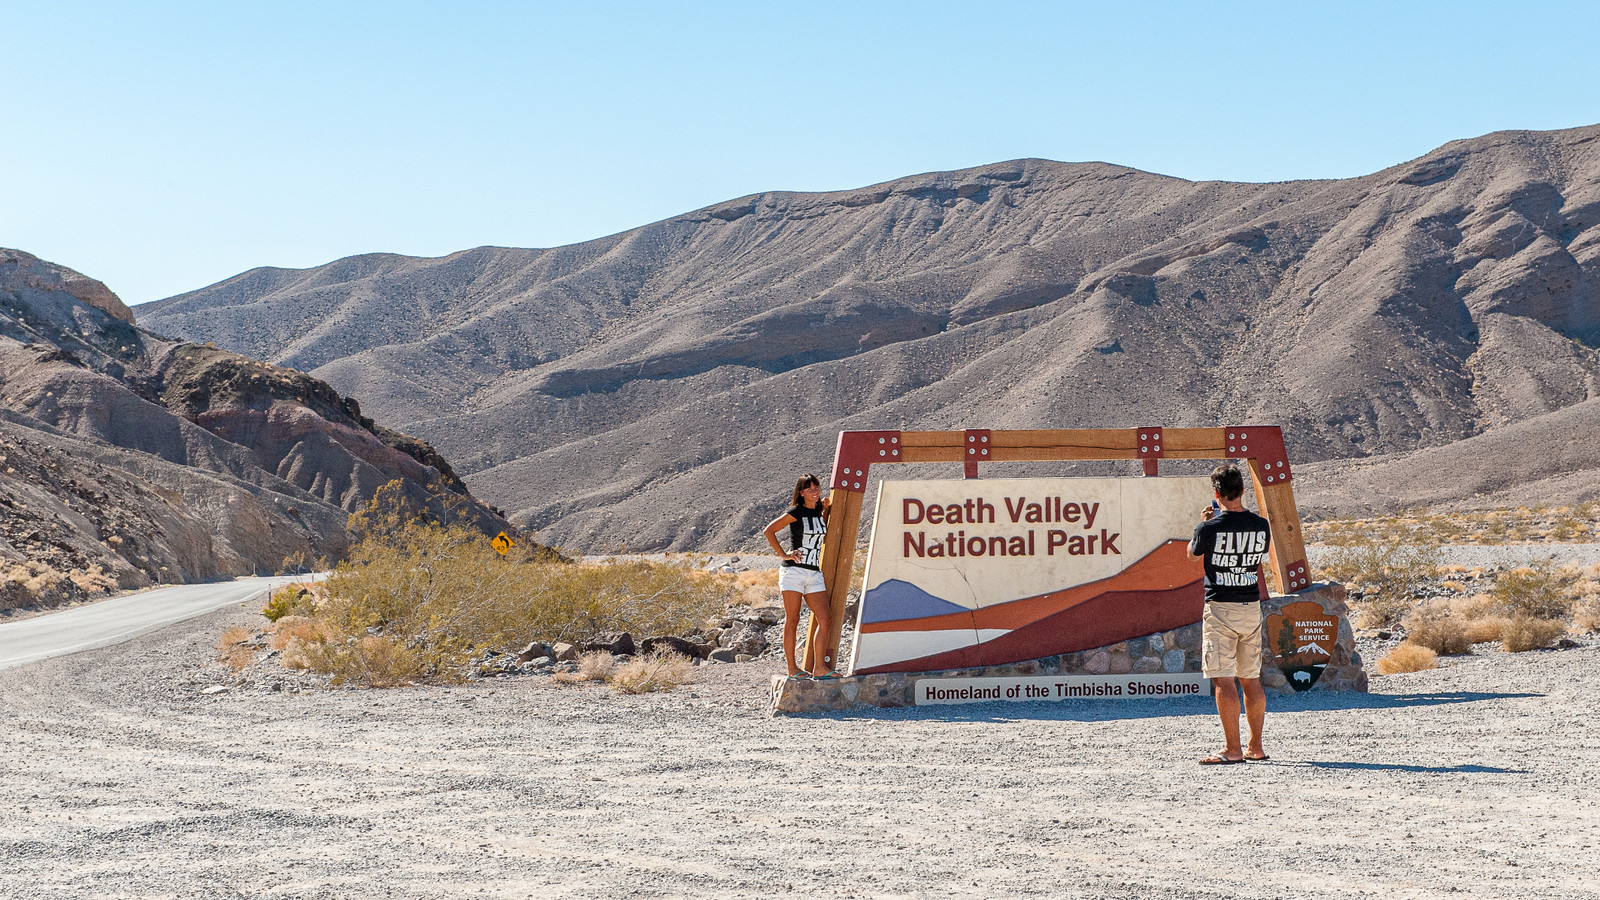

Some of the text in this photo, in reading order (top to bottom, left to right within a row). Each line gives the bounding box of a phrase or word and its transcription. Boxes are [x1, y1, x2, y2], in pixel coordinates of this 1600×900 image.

[903, 496, 1100, 529] Death Valley
[903, 528, 1122, 558] National Park
[1213, 531, 1266, 554] ELVIS
[1211, 552, 1263, 567] HAS LEFT
[925, 681, 1200, 700] Homeland of the Timbisha Shoshone
